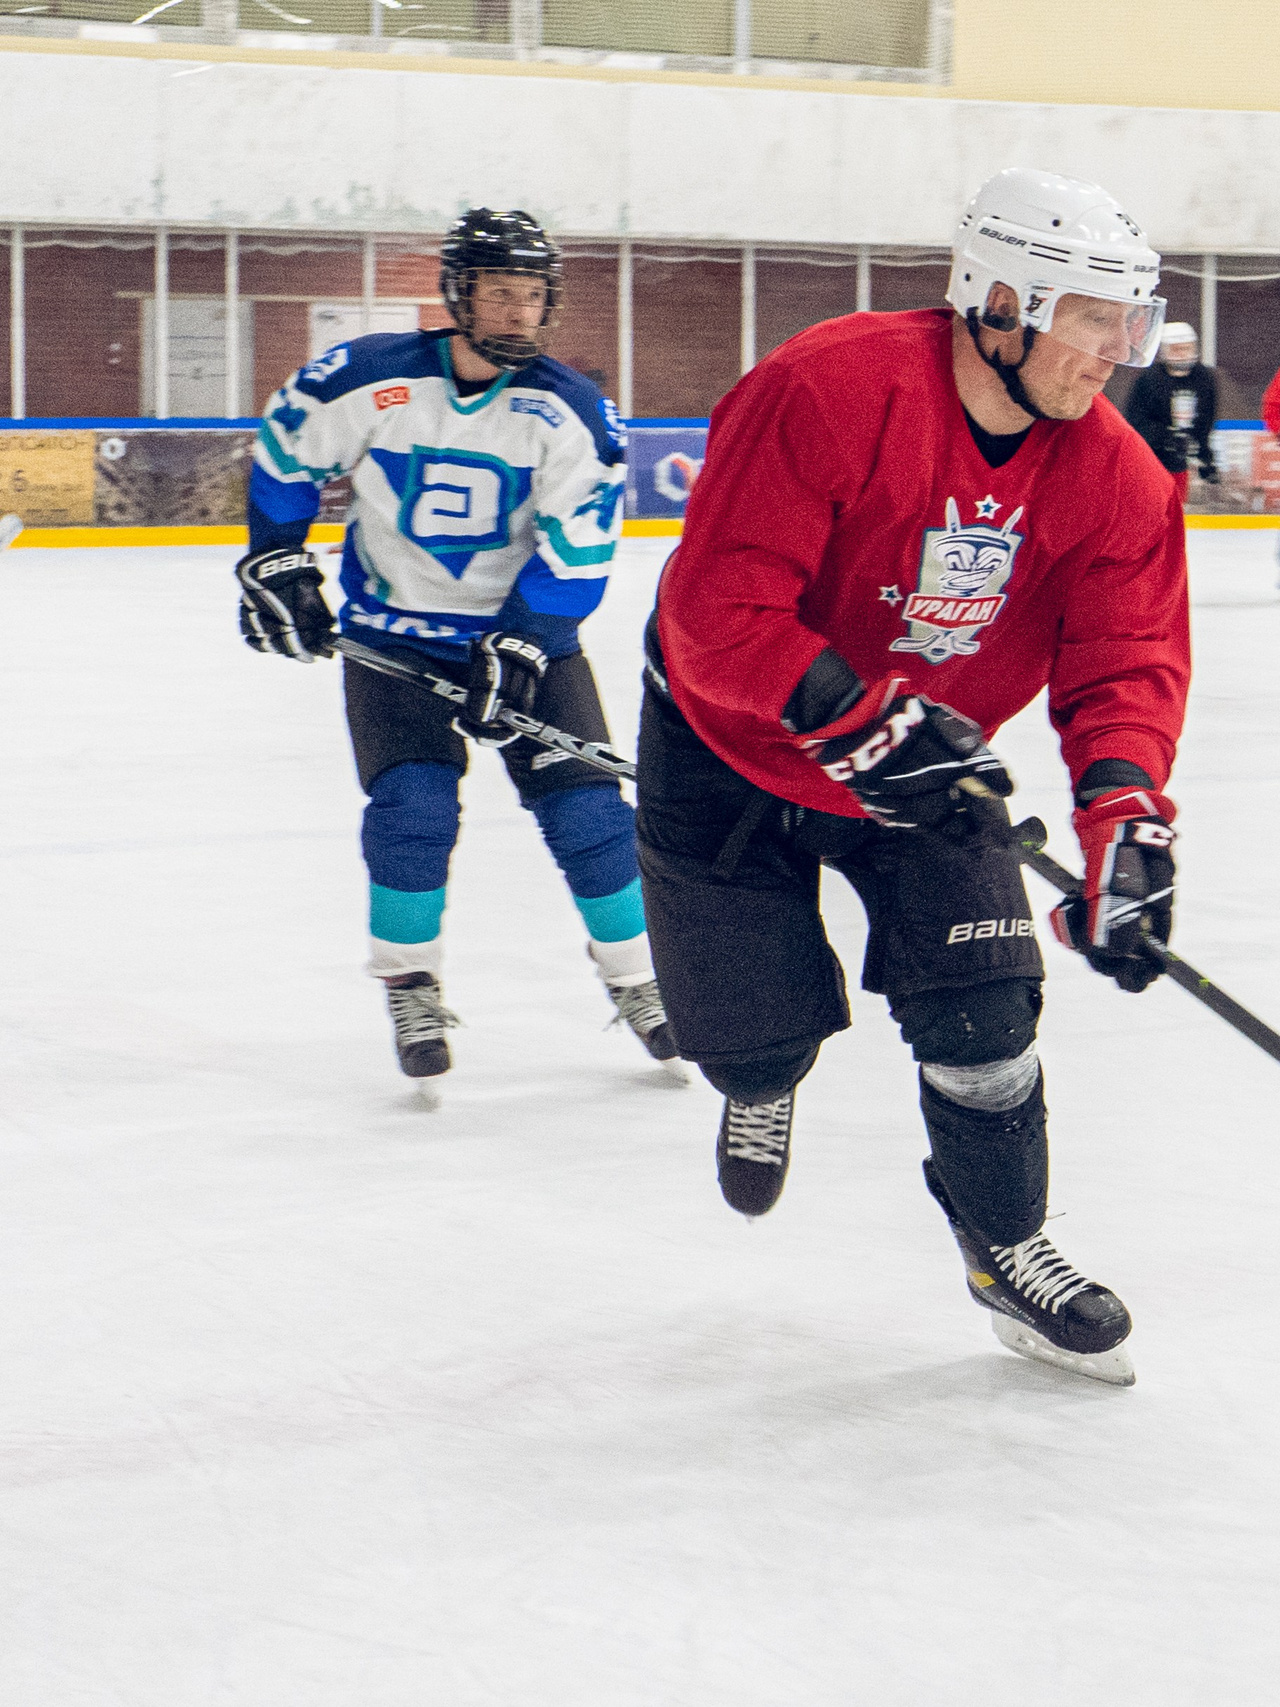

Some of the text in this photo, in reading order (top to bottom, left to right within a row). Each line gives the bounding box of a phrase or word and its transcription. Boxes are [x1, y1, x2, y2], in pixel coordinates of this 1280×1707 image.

[978, 226, 1027, 248] BAUER
[1133, 264, 1158, 274] BAUE
[257, 552, 318, 580] BAU
[907, 599, 997, 622] УРАГАН
[496, 637, 549, 676] BAU
[820, 697, 927, 782] CCM
